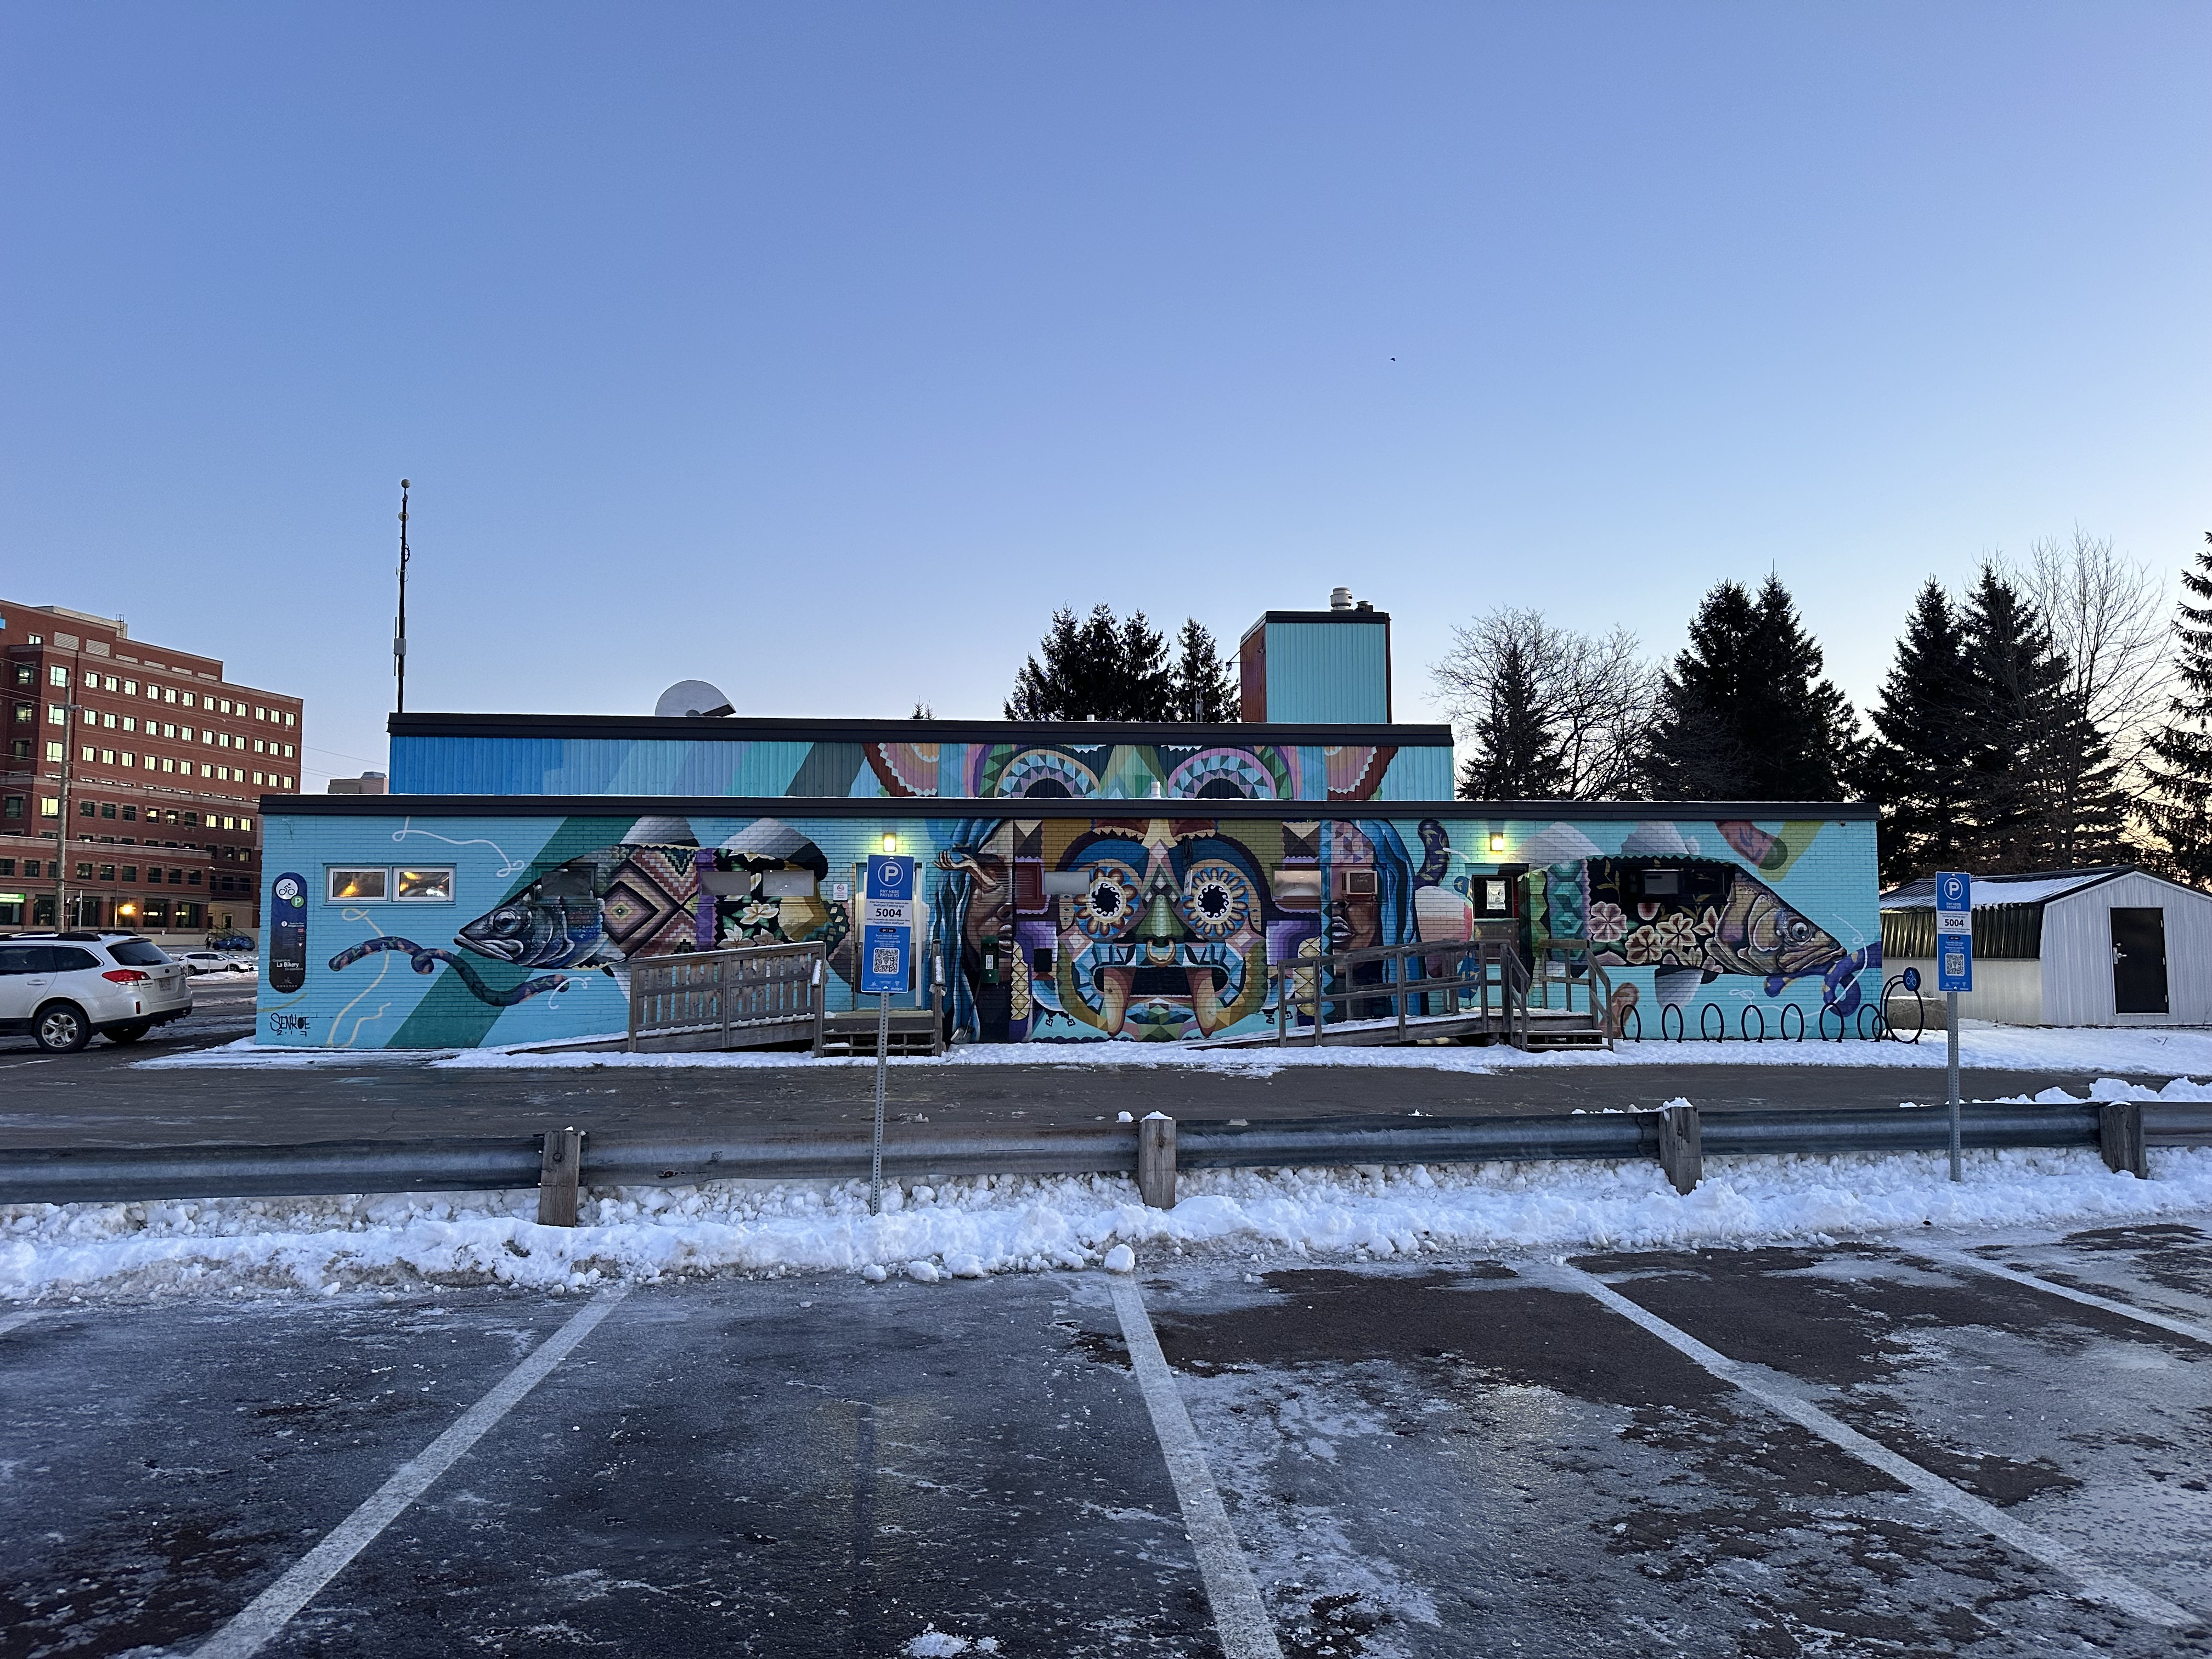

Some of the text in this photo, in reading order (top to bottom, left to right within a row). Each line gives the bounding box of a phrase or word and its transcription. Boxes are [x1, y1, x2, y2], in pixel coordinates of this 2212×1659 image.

[884, 866, 899, 882] P
[1949, 882, 1960, 896] P
[295, 897, 302, 906] P
[876, 908, 902, 918] 5004
[1944, 918, 1964, 927] 5004
